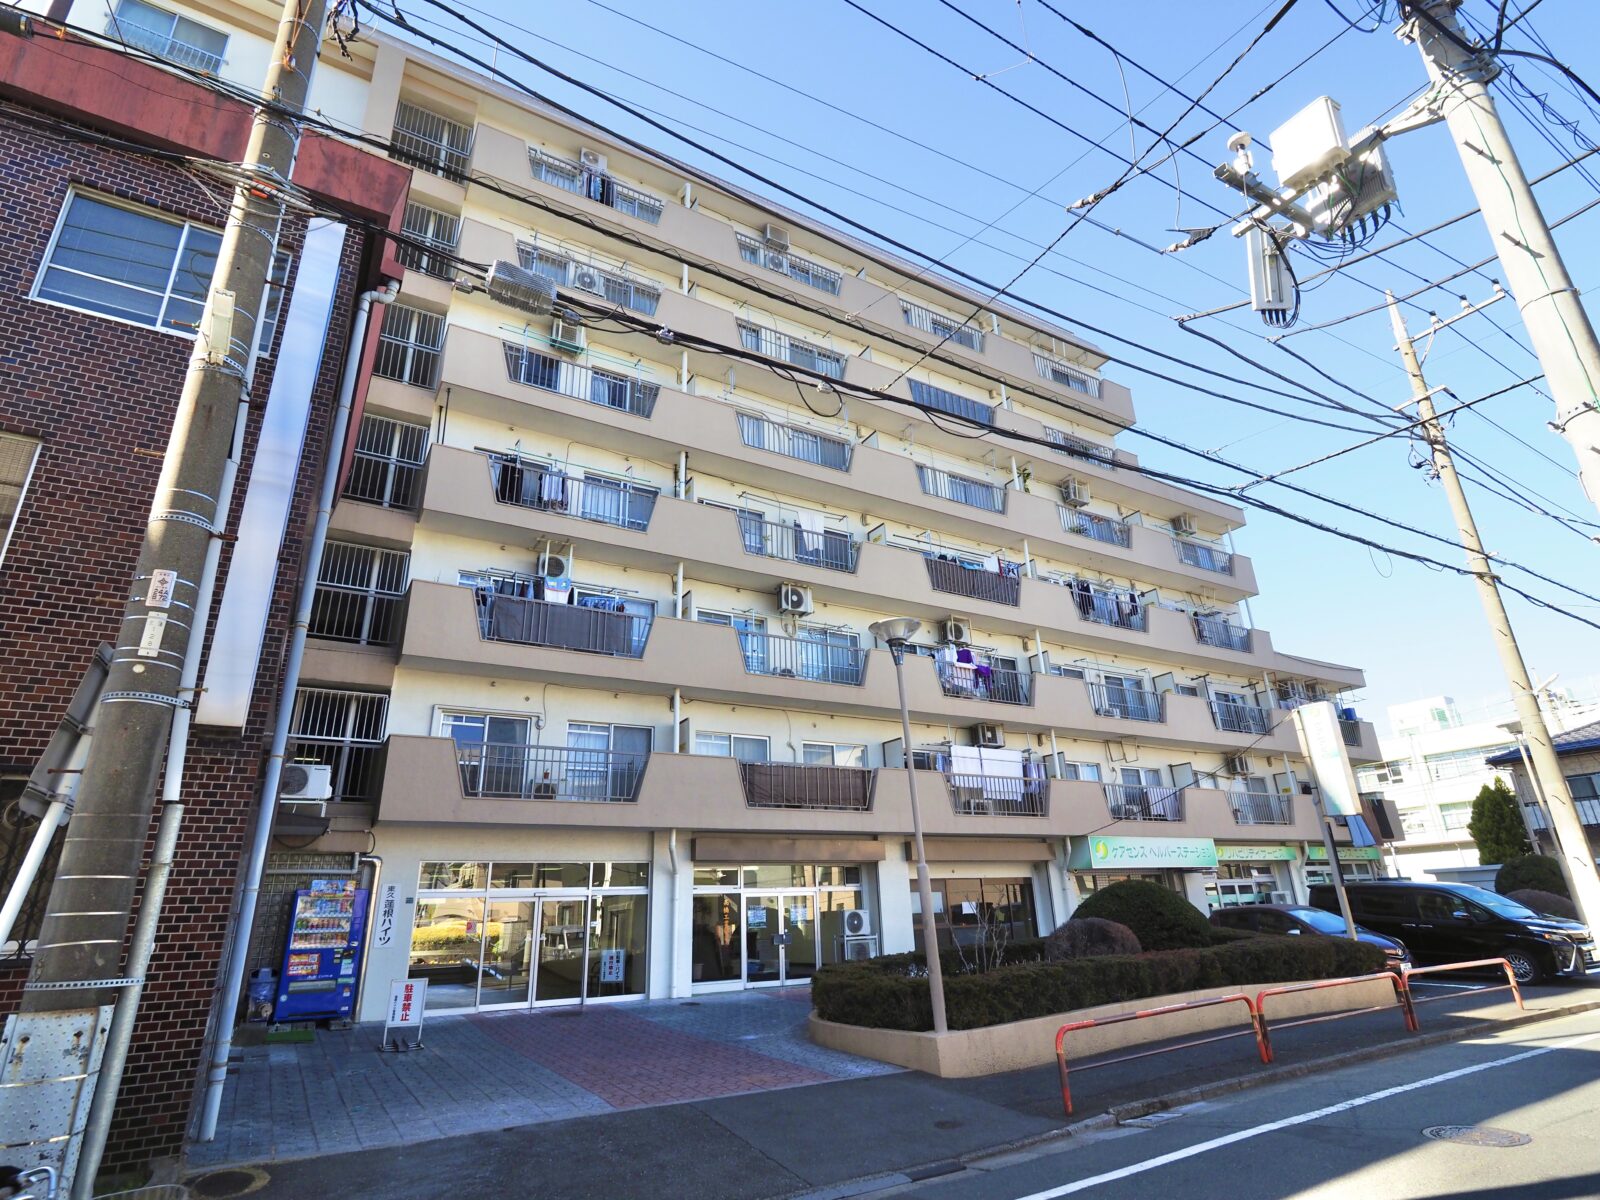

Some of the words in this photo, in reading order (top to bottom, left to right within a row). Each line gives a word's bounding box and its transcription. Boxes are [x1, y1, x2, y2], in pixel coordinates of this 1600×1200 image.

[1111, 846, 1148, 859] ケアセンス
[400, 983, 414, 1021] 駐車禁止
